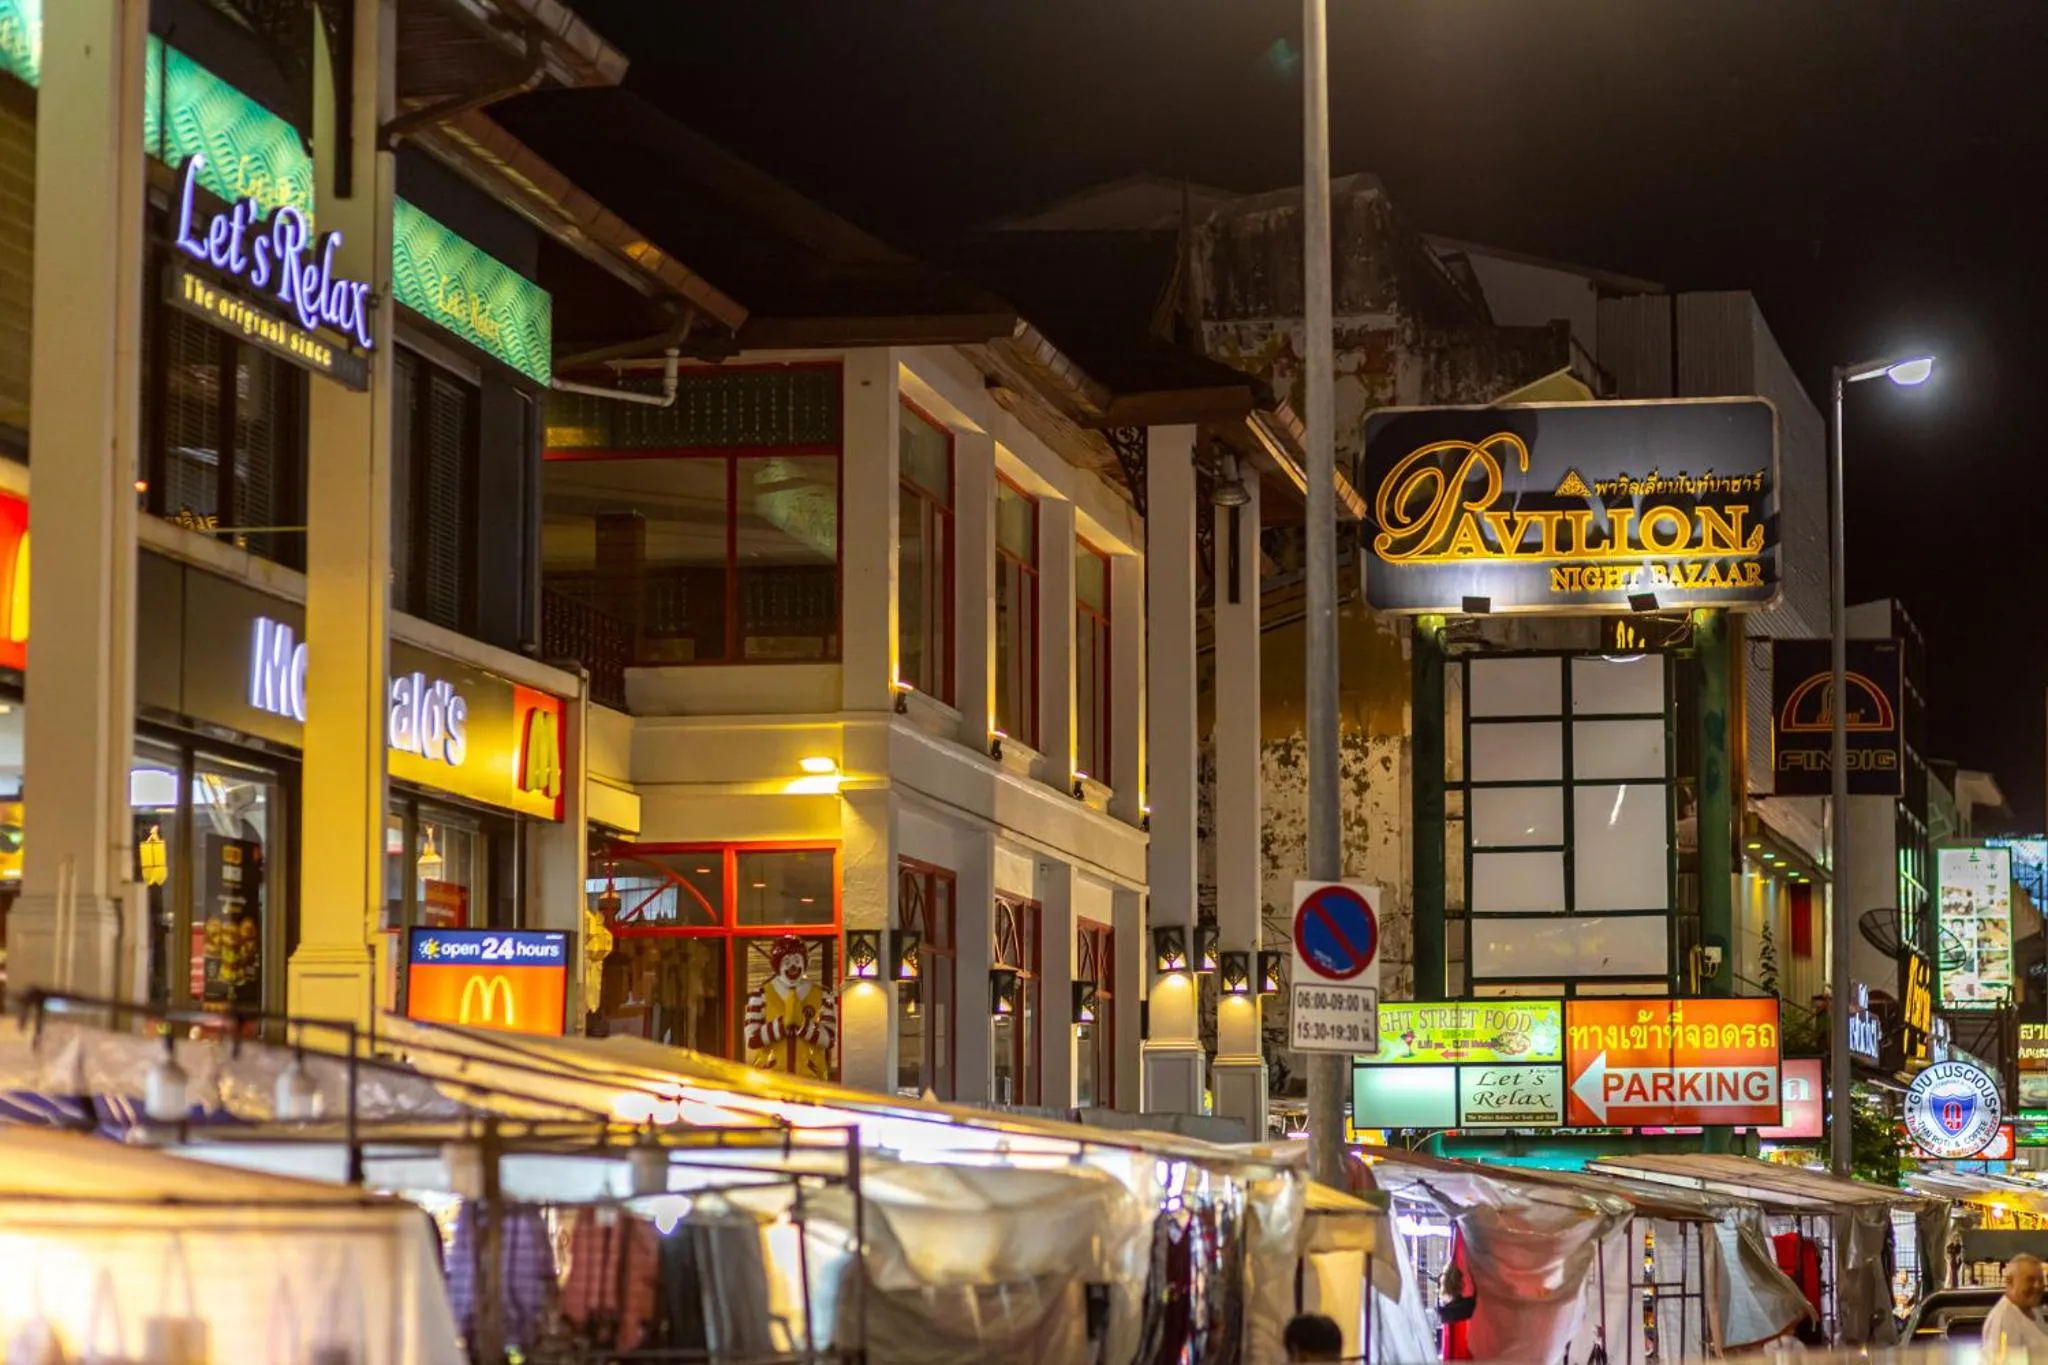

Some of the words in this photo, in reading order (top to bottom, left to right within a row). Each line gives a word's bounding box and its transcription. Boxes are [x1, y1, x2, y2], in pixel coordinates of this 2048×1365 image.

[176, 152, 271, 287] Let's
[272, 205, 373, 348] Relax
[183, 272, 215, 310] The
[218, 299, 287, 345] original
[289, 330, 333, 367] since
[1375, 432, 1763, 564] PAVILION
[1551, 565, 1644, 592] NIGHT
[1650, 560, 1766, 589] BAZAAR
[441, 942, 480, 958] open
[481, 937, 515, 960] 24
[516, 941, 560, 957] hours
[1379, 1011, 1413, 1033] GHT
[1419, 1008, 1480, 1029] STREET
[1483, 1010, 1533, 1034] FOOD
[1568, 1000, 1776, 1050] ทางเข้าที่จอดรถ
[1476, 1068, 1546, 1086] Let's
[1603, 1072, 1770, 1102] PARKING
[1908, 1074, 1933, 1105] GUU
[1934, 1065, 1997, 1108] LUSCIOUS
[1472, 1087, 1554, 1109] Relax
[1963, 1120, 1989, 1144] COFFEE
